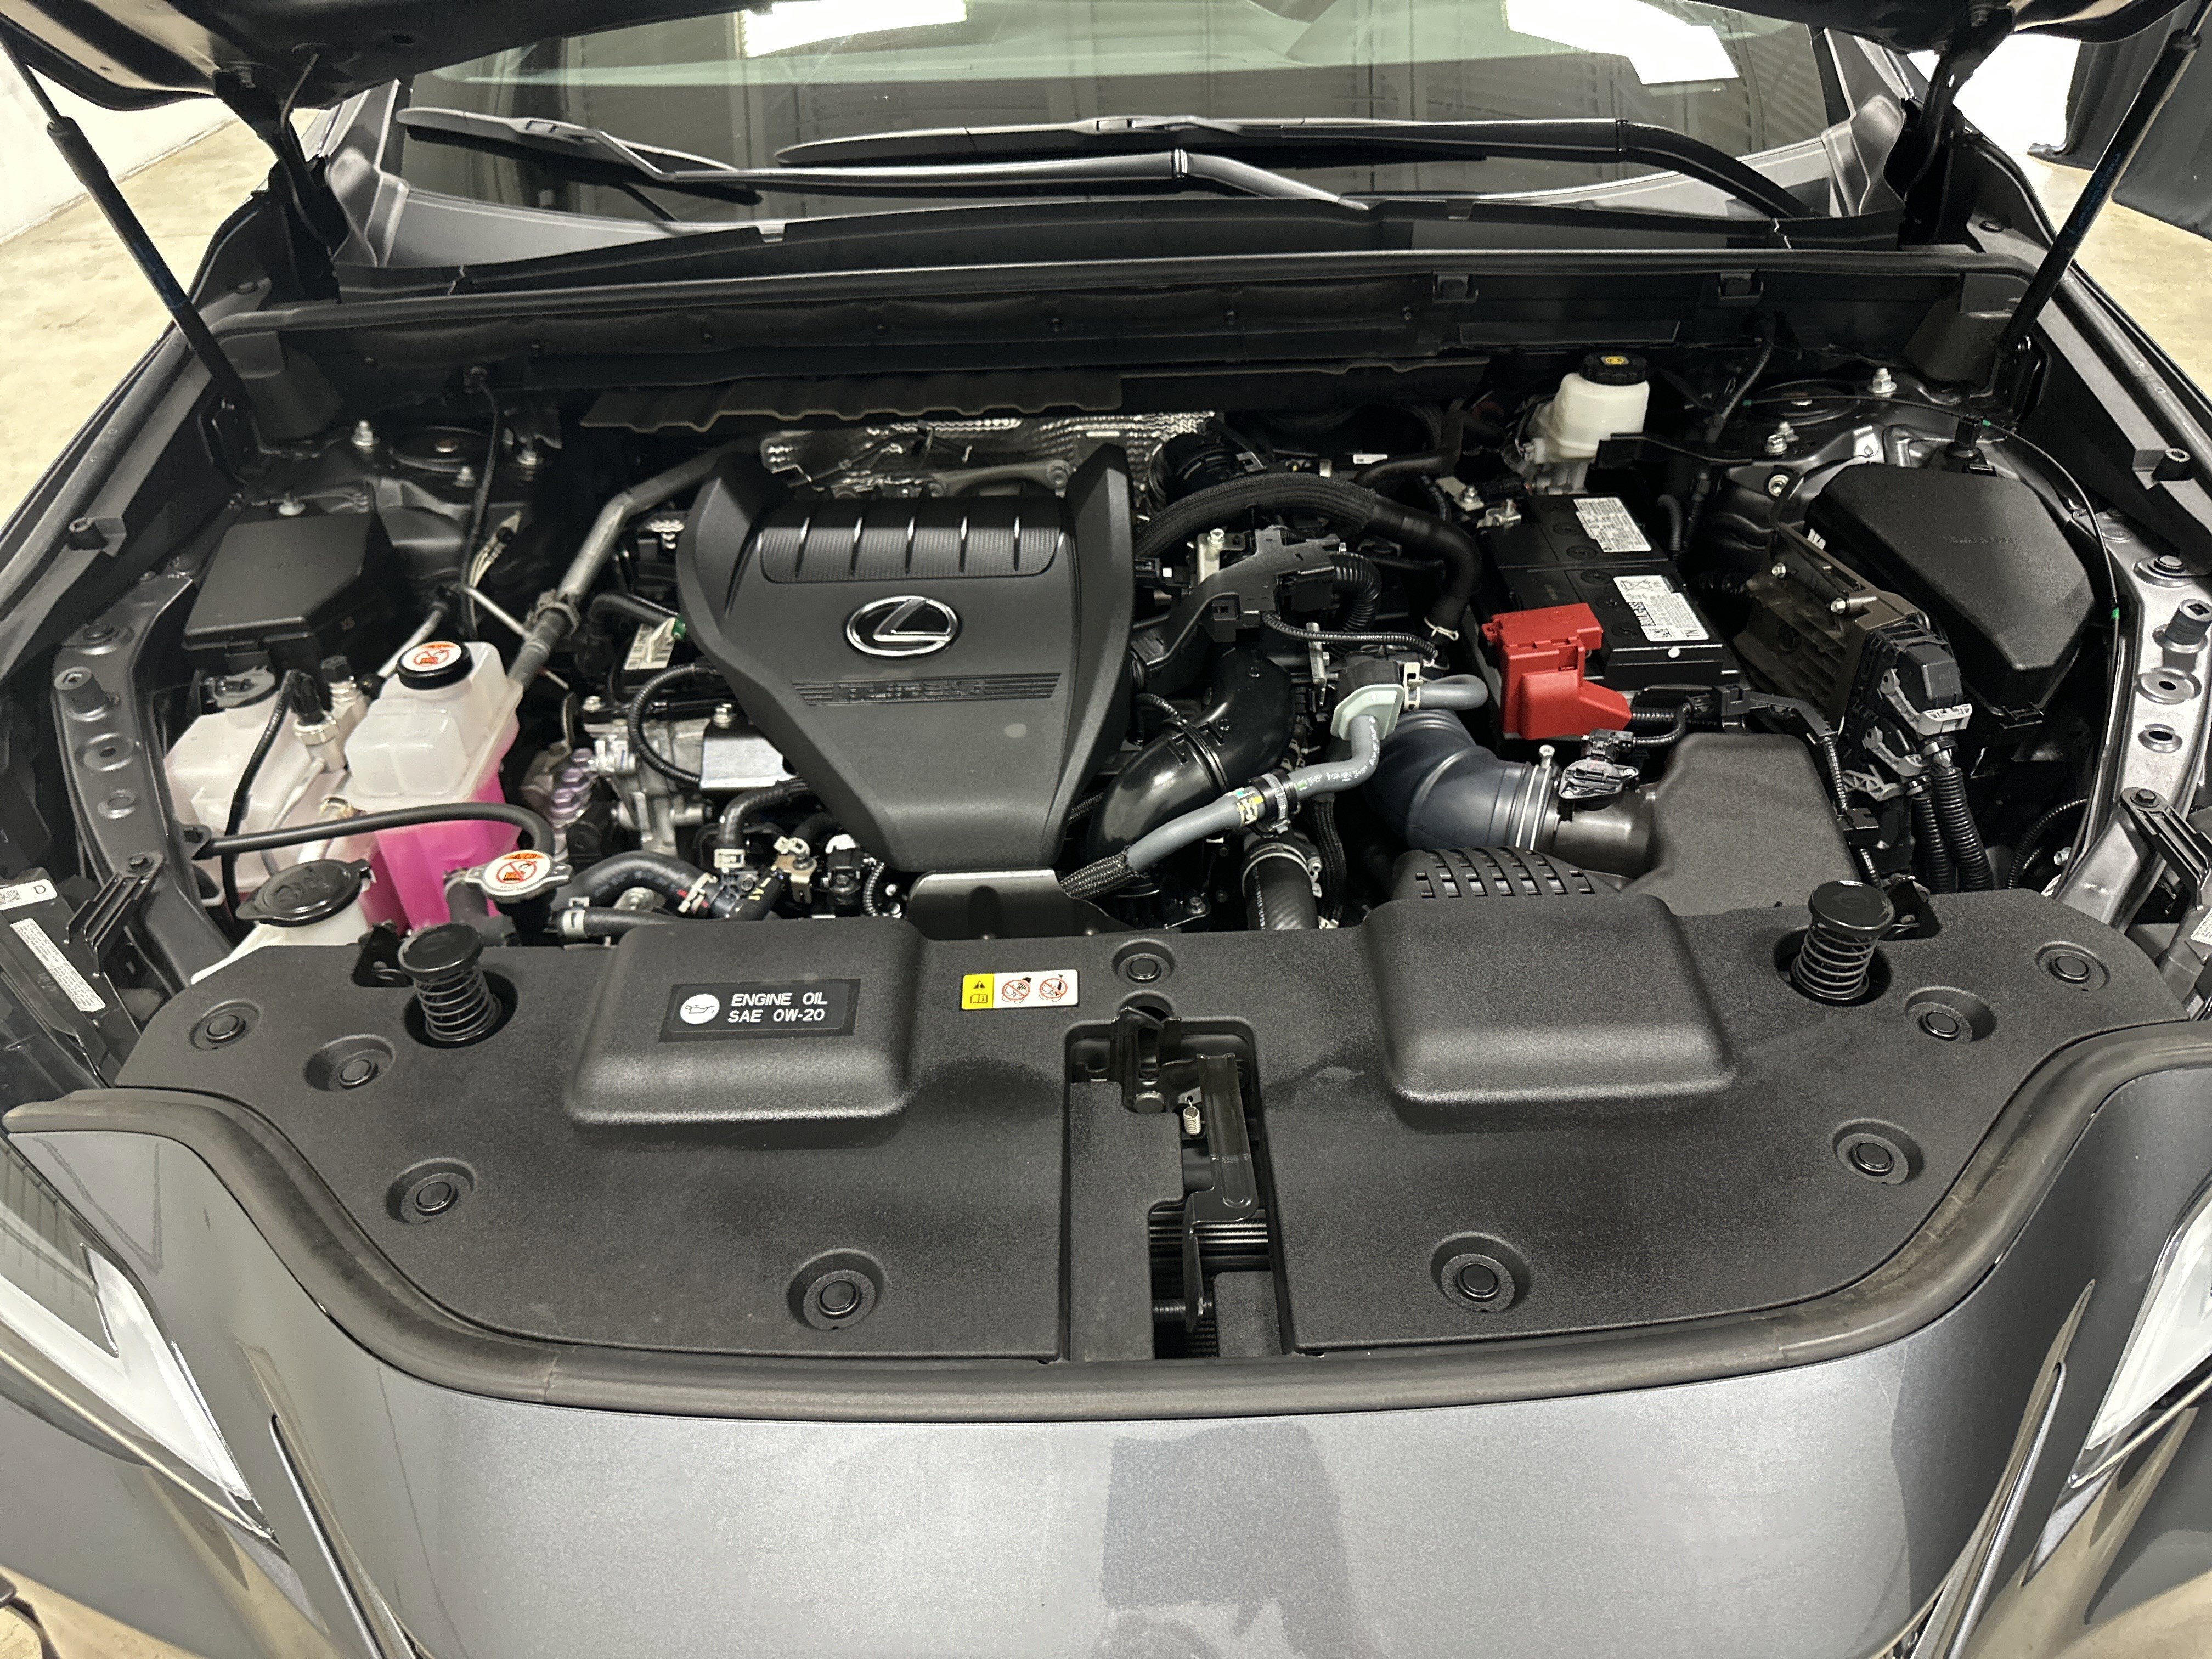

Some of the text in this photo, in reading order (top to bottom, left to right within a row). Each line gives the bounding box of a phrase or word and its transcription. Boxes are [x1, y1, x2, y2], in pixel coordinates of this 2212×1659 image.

[33, 885, 47, 895] D
[731, 992, 828, 1006] ENGINE OIL
[727, 1008, 825, 1023] SAE 0W-20
